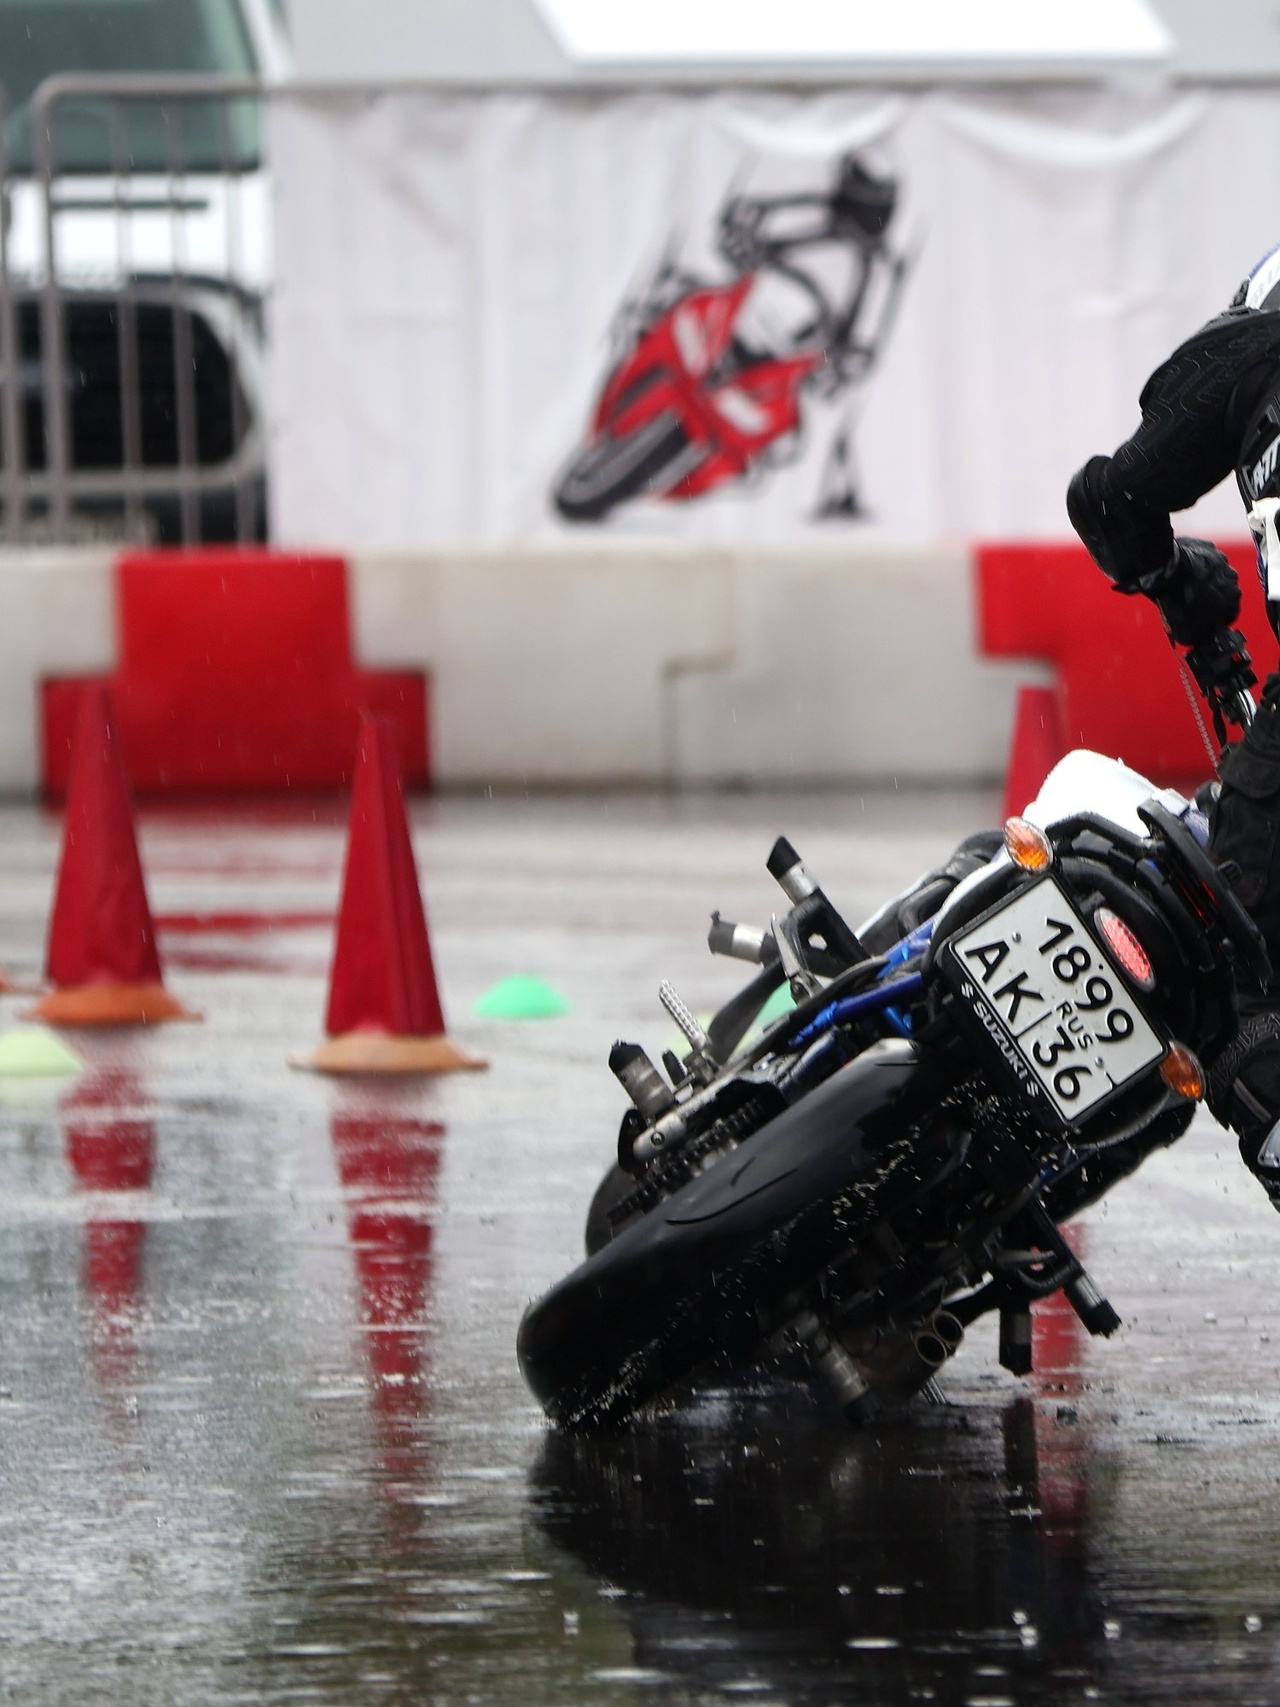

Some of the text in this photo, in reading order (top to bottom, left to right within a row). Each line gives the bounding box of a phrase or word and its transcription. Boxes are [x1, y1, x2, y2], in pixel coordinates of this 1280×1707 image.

[1037, 917, 1134, 1043] 1899
[973, 1002, 1029, 1080] SUZUKI
[1032, 1026, 1092, 1100] 36
[1056, 1001, 1093, 1049] RUS
